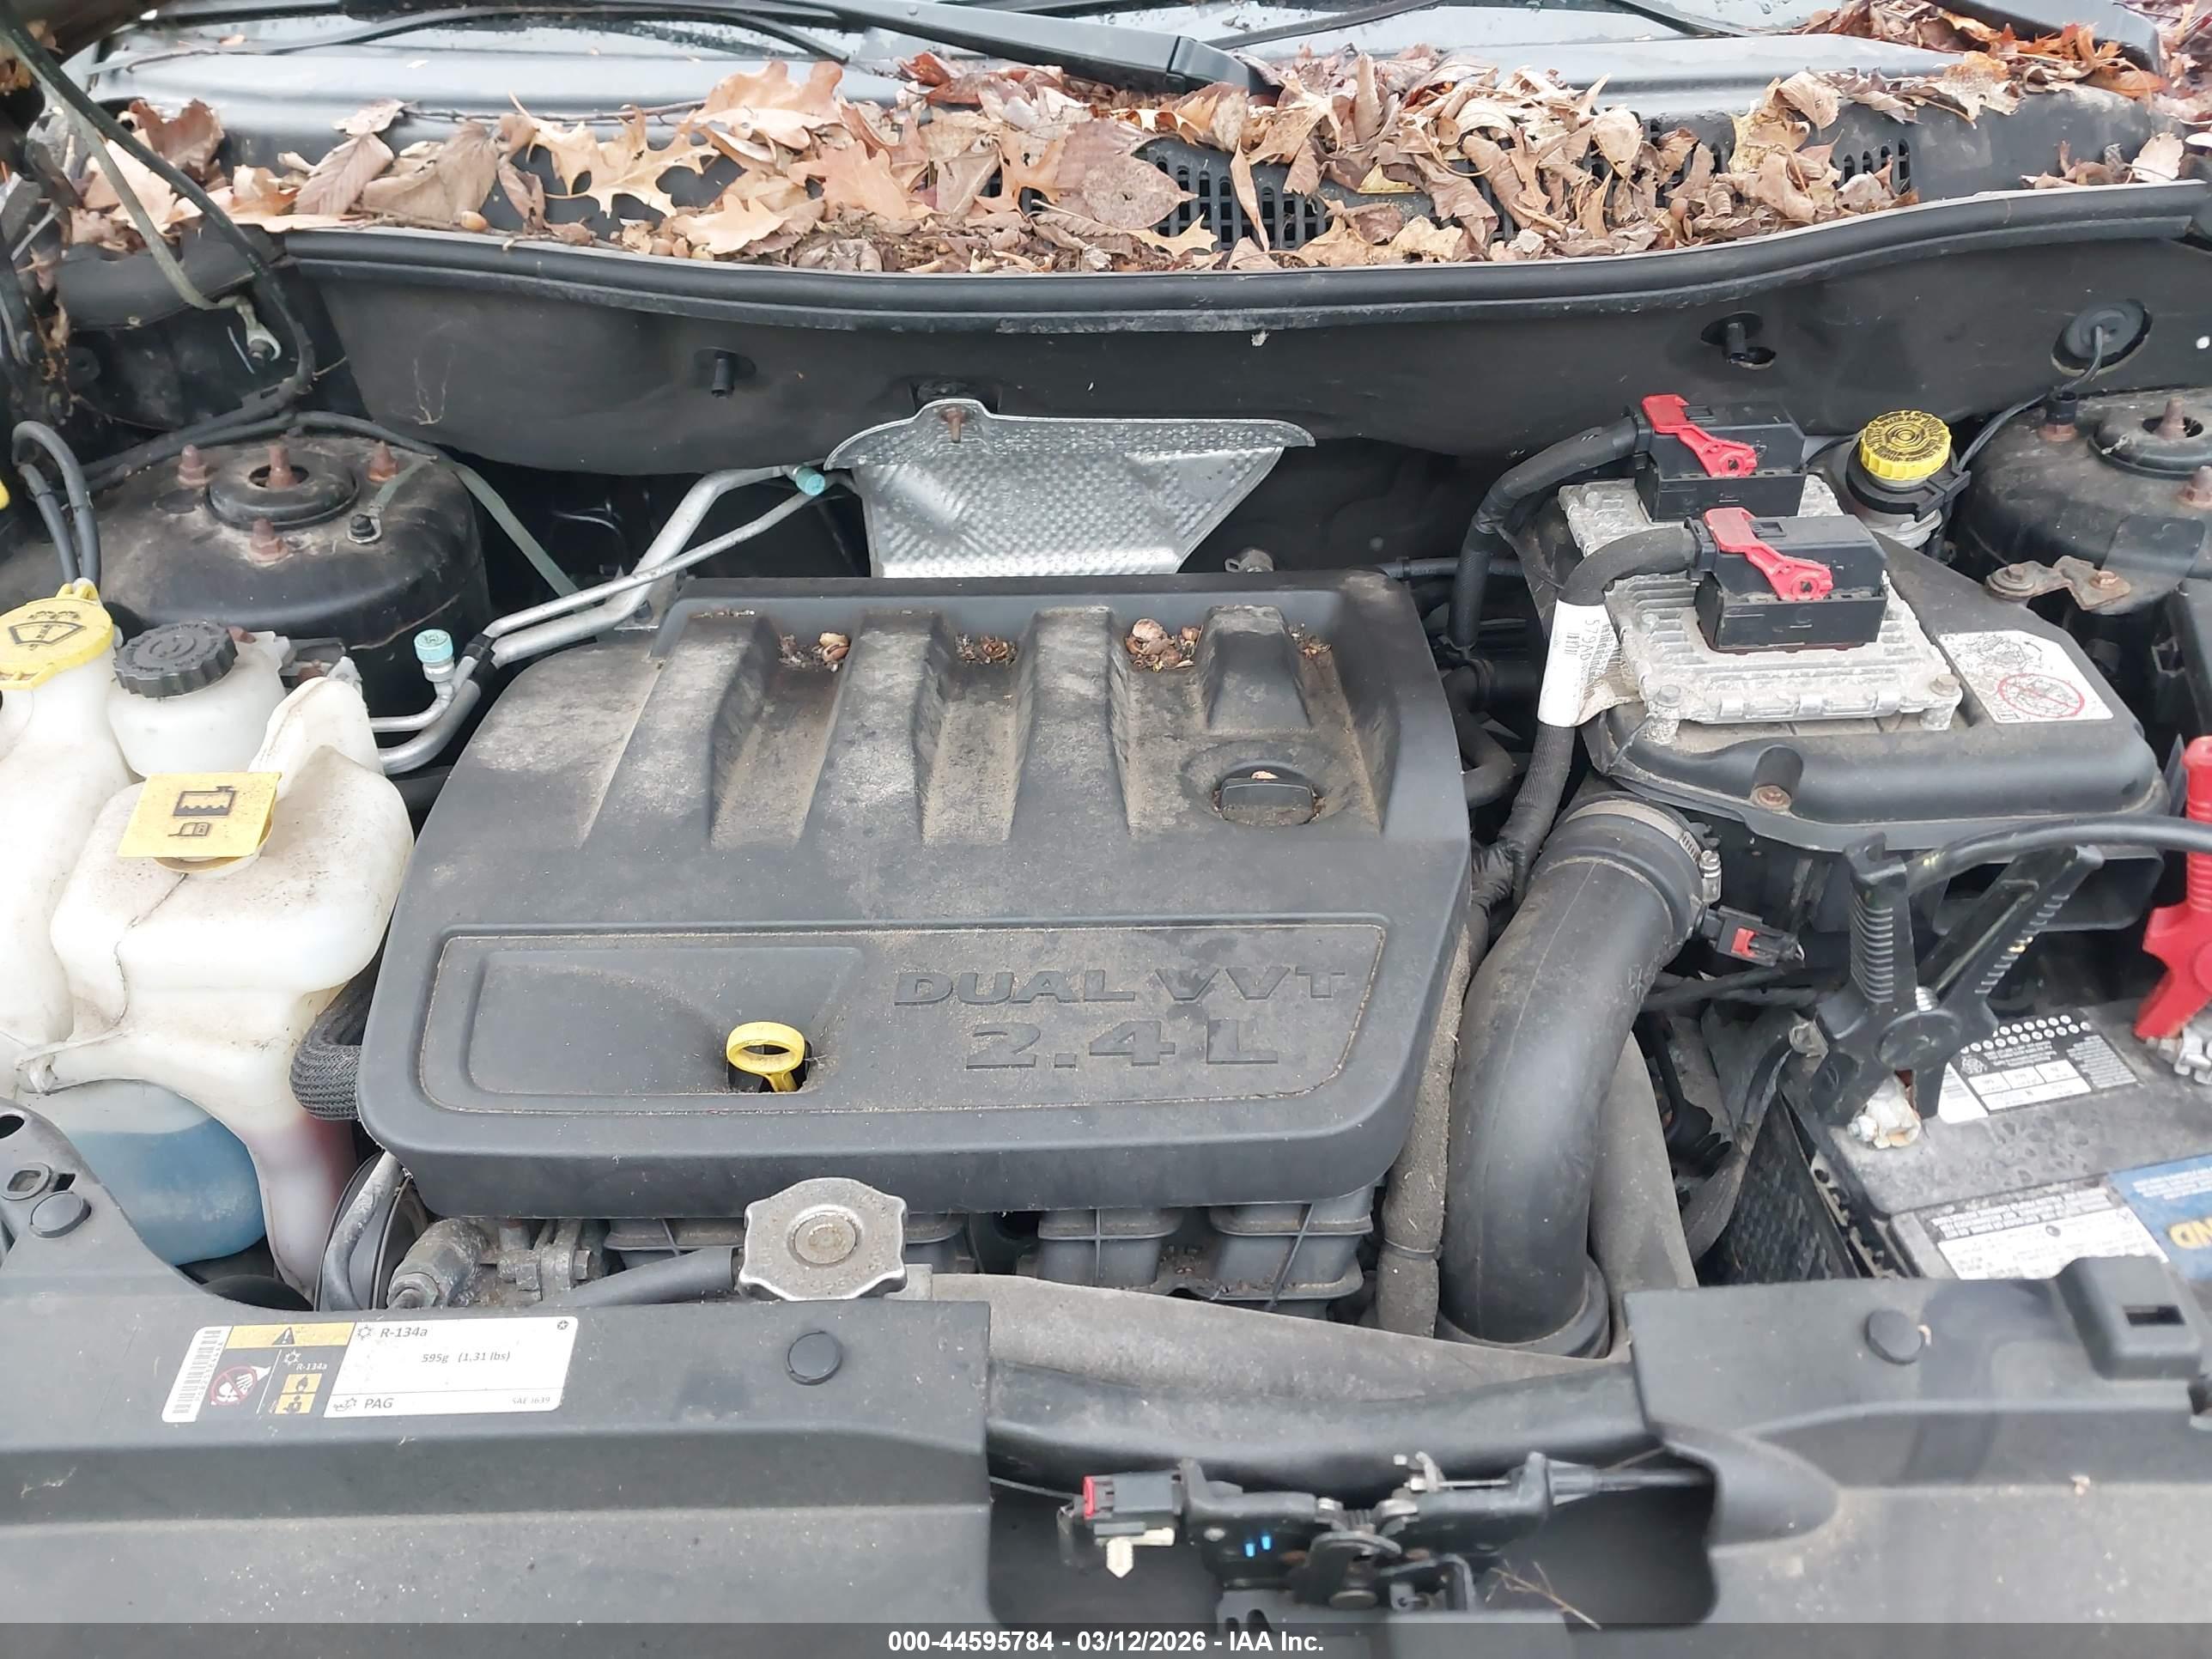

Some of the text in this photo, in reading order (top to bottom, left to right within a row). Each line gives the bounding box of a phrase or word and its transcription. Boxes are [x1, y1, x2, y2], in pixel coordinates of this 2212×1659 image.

[894, 968, 1346, 1006] DUAL VVT
[965, 1018, 1279, 1070] 2.4L
[380, 1327, 428, 1338] R-134a
[421, 1353, 449, 1364] 595g
[489, 1352, 511, 1362] lbs)
[295, 1363, 328, 1371] R-134a
[364, 1398, 393, 1409] PAG
